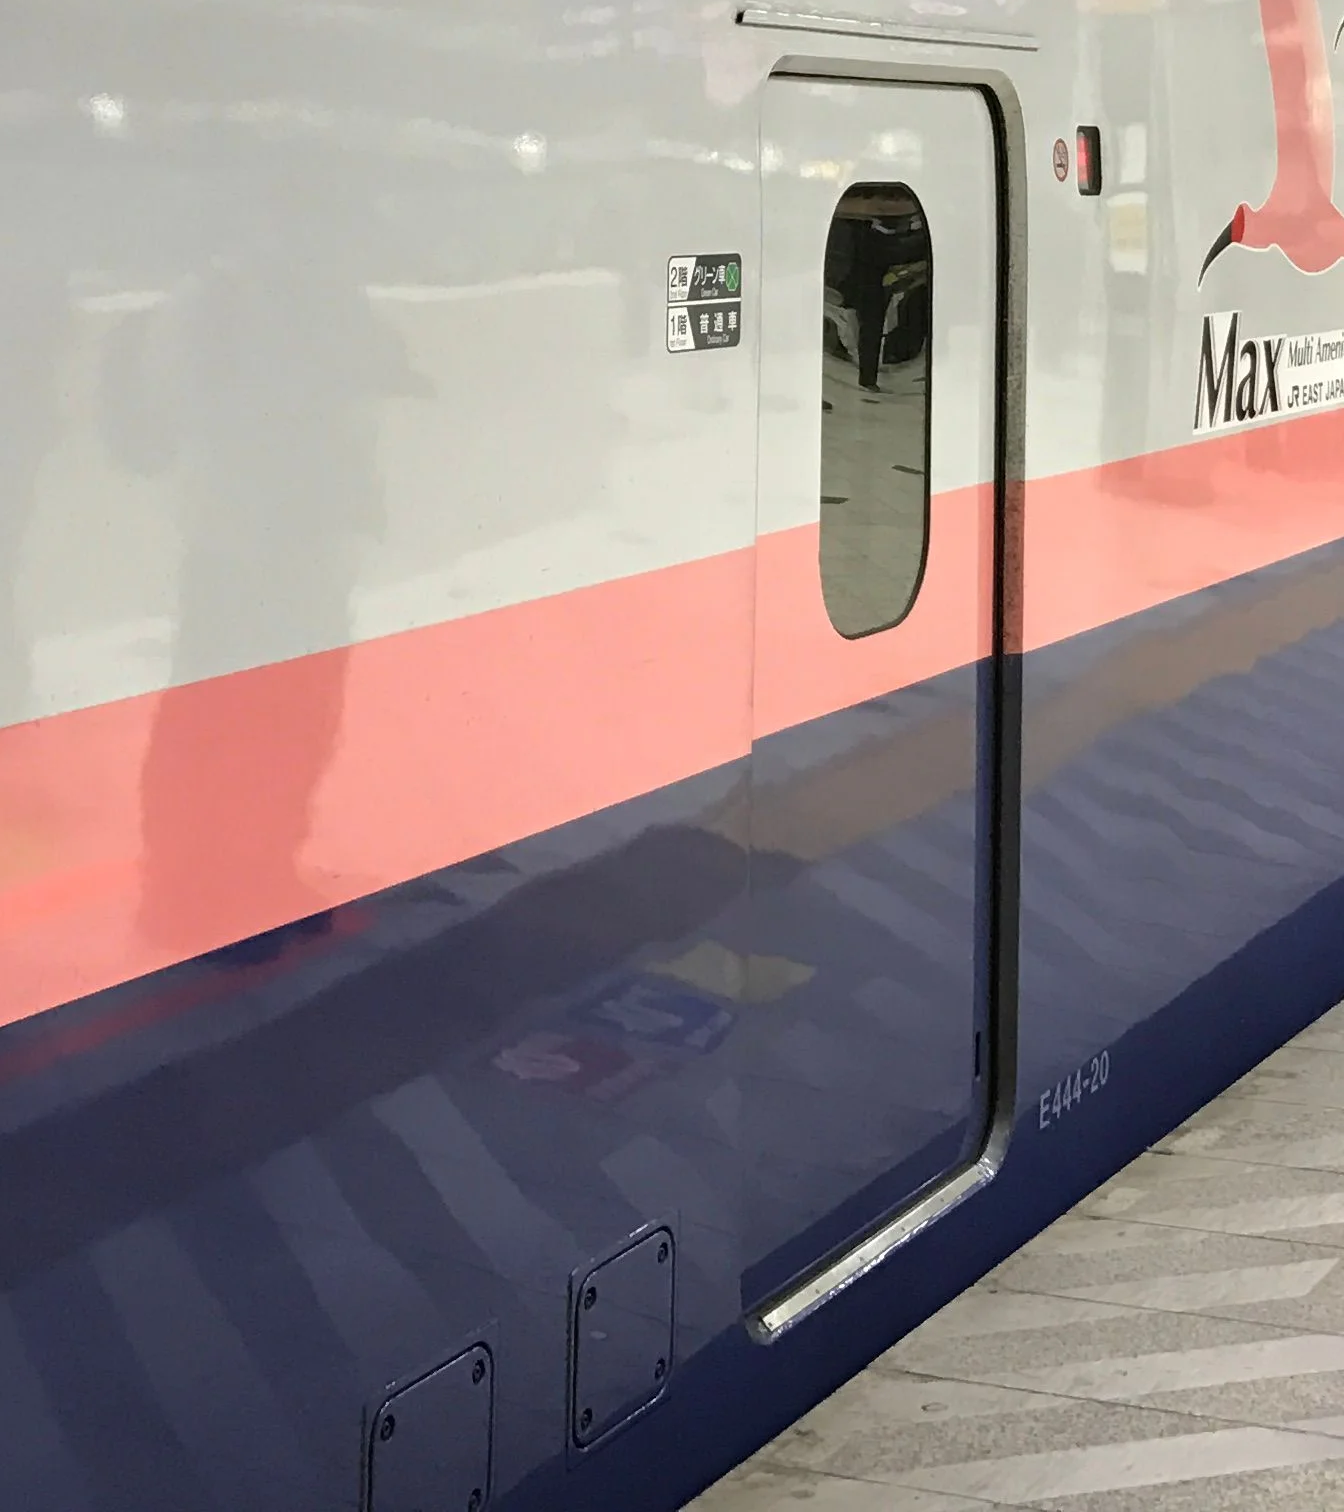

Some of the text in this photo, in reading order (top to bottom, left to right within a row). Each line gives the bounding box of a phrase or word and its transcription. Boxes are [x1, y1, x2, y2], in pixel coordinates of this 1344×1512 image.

[670, 265, 726, 288] 2階 グリーン車
[670, 311, 737, 336] 1階 普通車
[1287, 336, 1314, 368] Multi
[1193, 311, 1285, 430] Max
[1287, 385, 1300, 408] JR
[1302, 382, 1324, 406] EAST
[1039, 1050, 1110, 1129] E444-20
